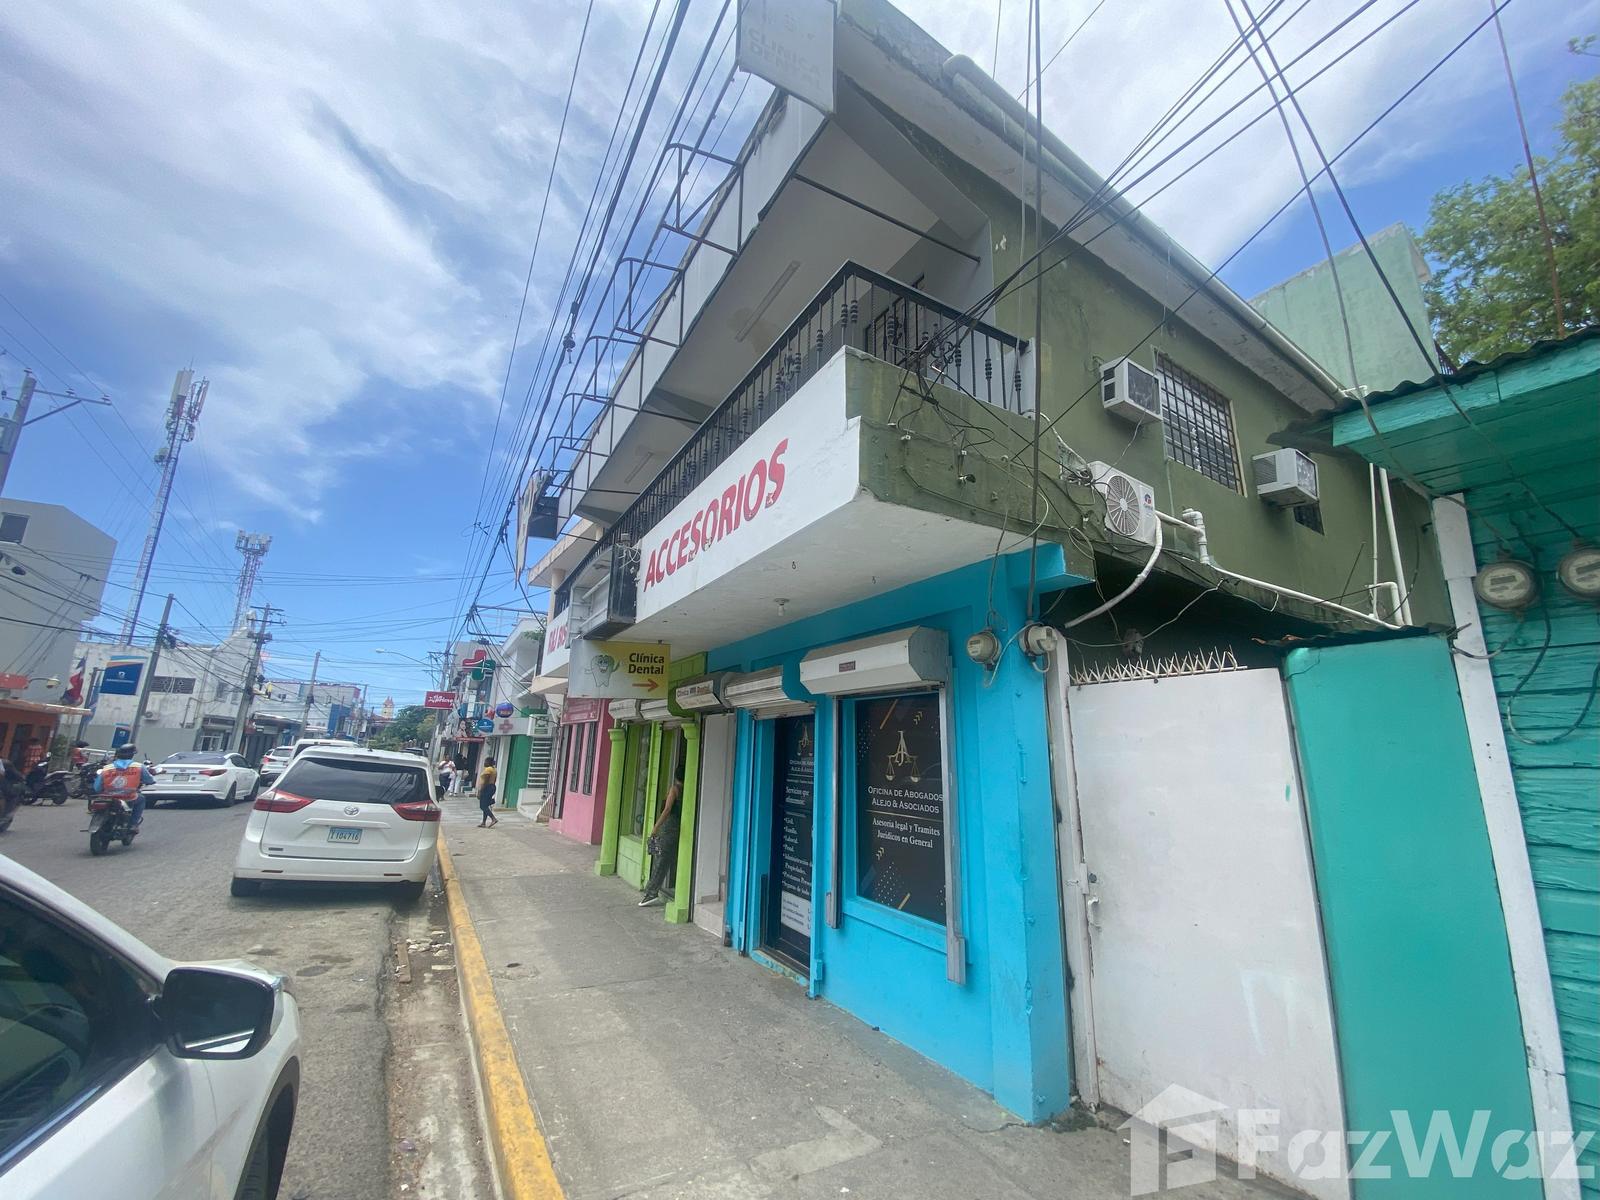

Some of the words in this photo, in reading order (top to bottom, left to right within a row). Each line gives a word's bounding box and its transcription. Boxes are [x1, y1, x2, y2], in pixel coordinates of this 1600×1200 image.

[643, 437, 789, 593] ACCESORIOS
[629, 652, 665, 664] Clínica
[628, 663, 664, 675] Dental
[867, 785, 893, 797] OFICINA
[893, 789, 903, 797] DE
[904, 789, 944, 802] ABOGADOS
[871, 797, 892, 807] ALEJO
[892, 799, 898, 808] &
[899, 800, 940, 814] ASOCIADOS
[895, 820, 908, 832] legal
[908, 824, 913, 833] y
[913, 823, 941, 837] Tramites
[901, 836, 909, 844] en
[909, 835, 933, 848] General
